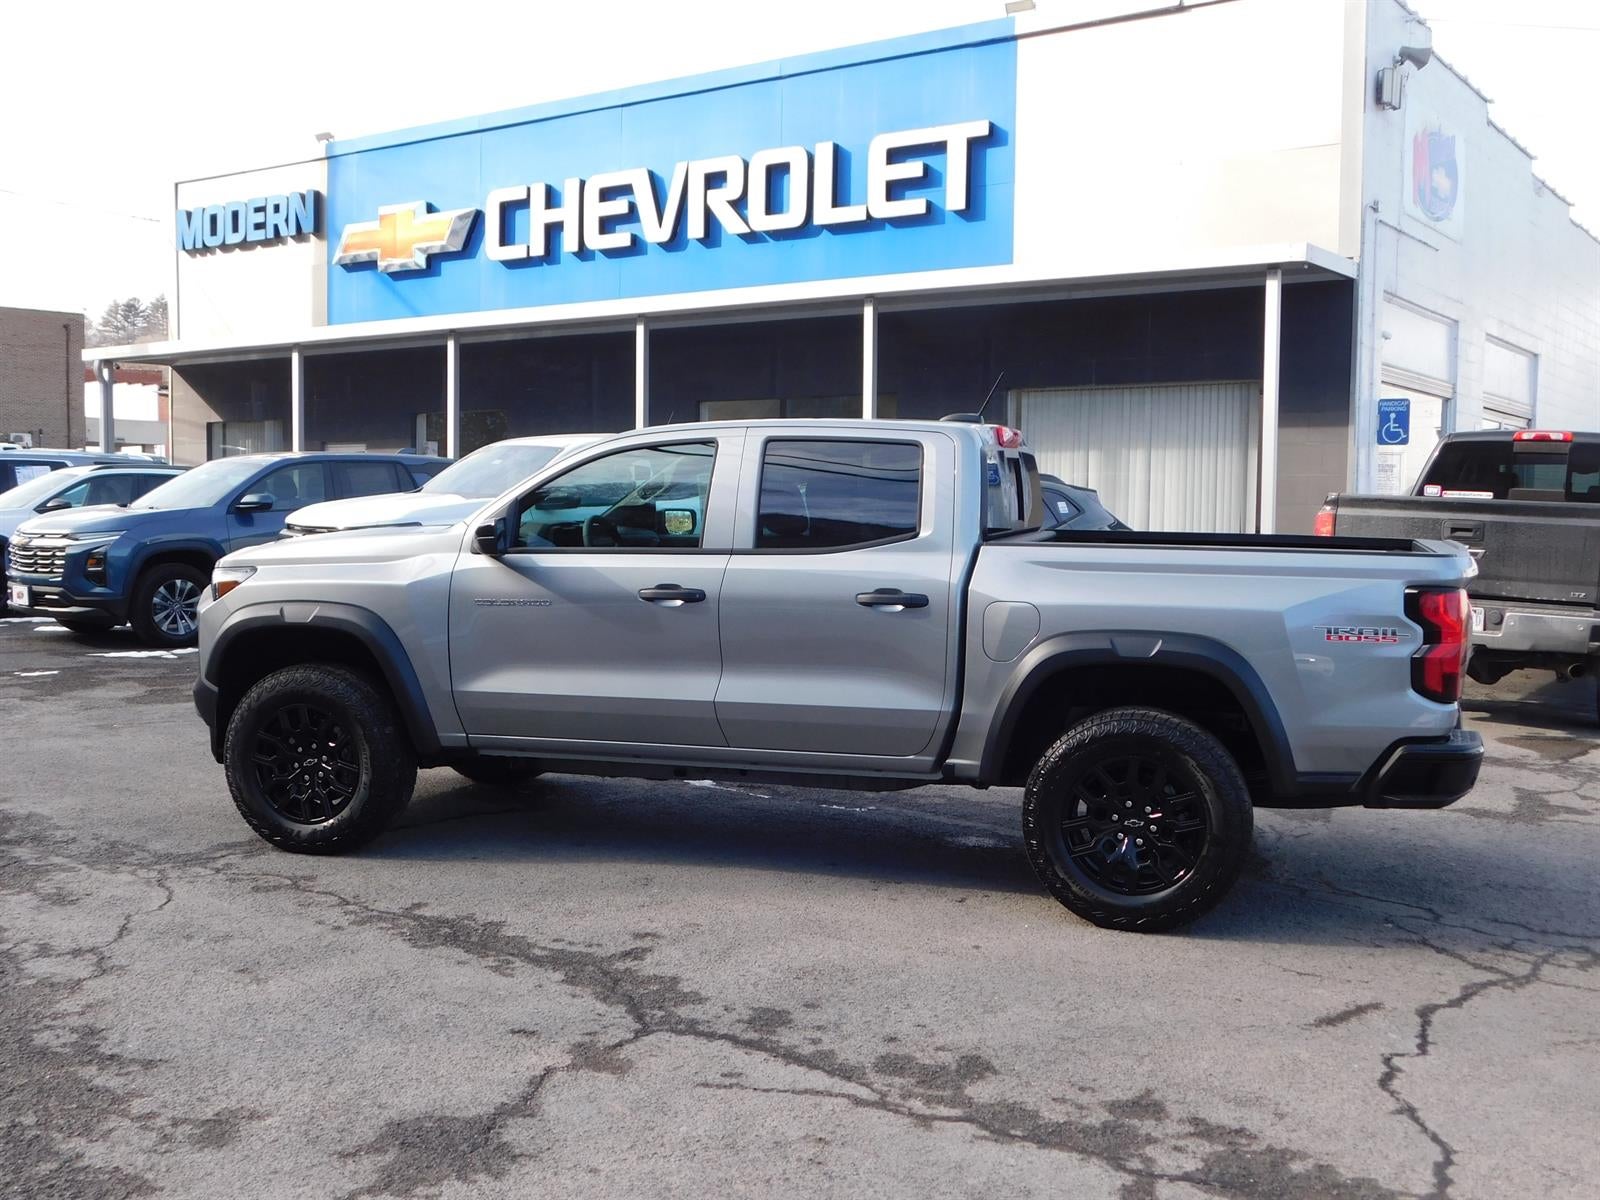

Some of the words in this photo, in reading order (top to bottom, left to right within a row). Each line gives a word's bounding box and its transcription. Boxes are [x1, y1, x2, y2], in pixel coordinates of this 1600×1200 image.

[485, 119, 992, 263] CHEVROLET
[176, 189, 317, 251] MODERN
[1570, 591, 1587, 599] LTZ
[1313, 626, 1411, 638] TRAIL
[1325, 635, 1399, 644] BOSS
